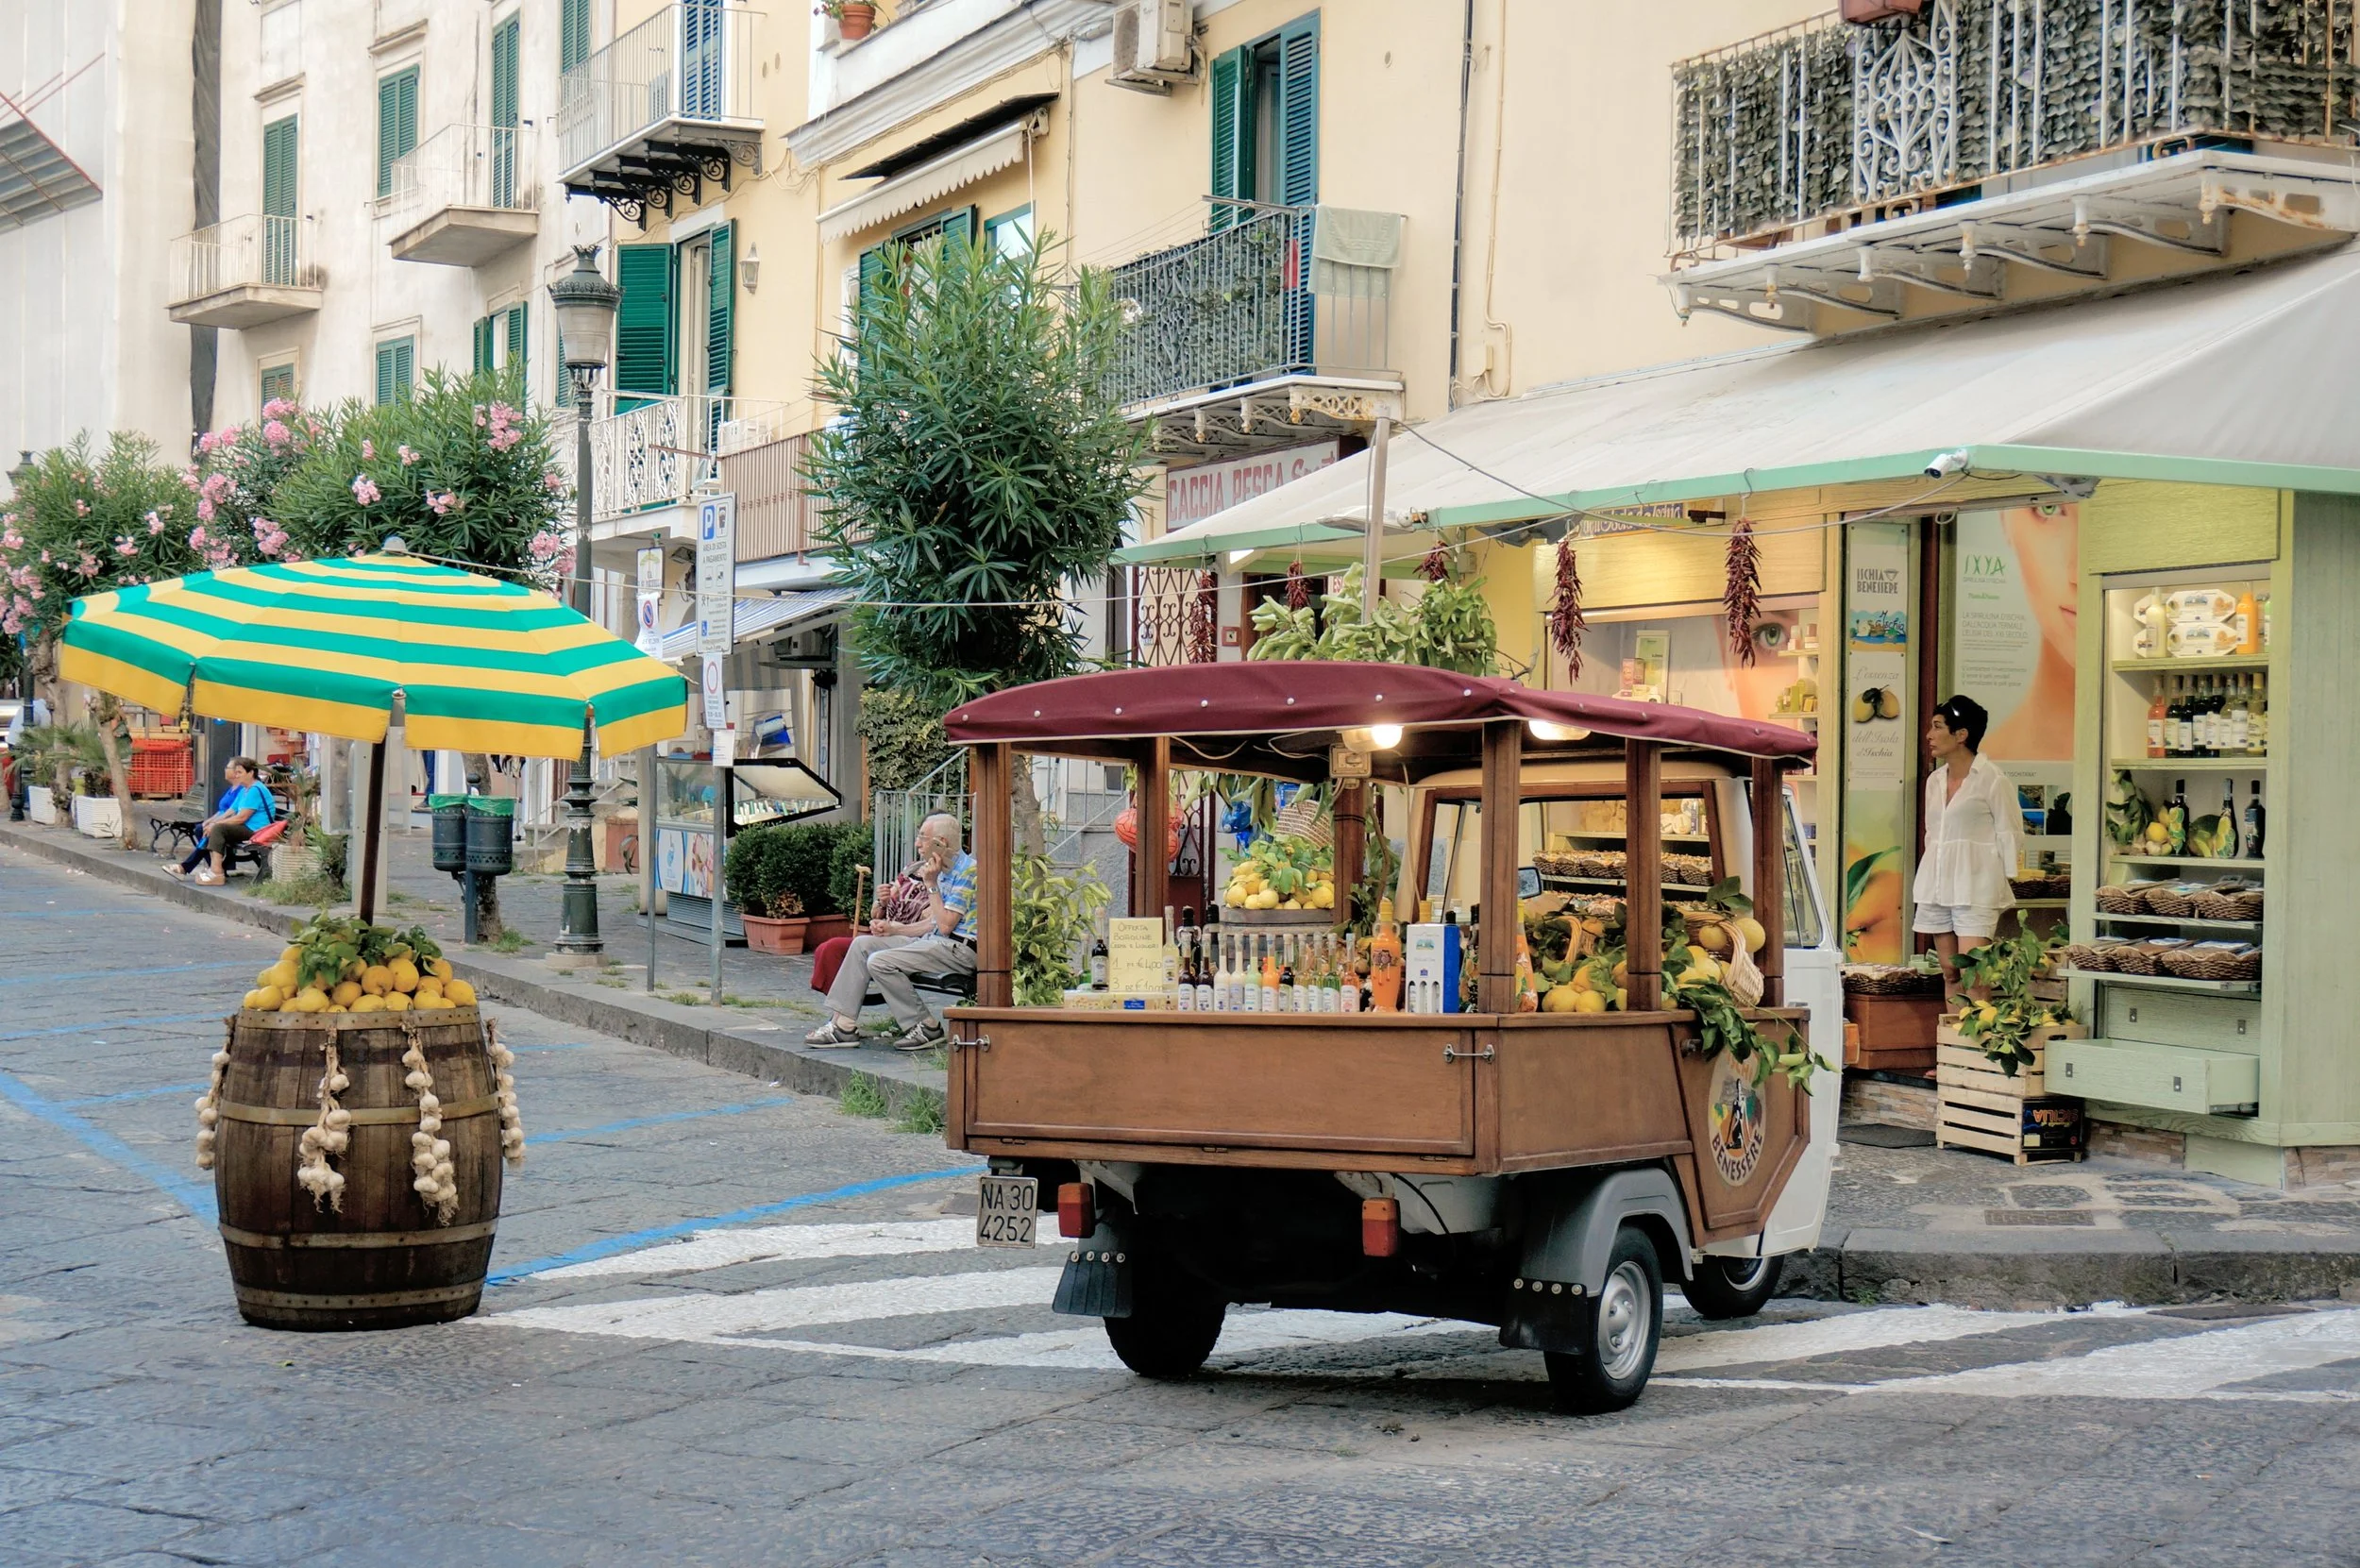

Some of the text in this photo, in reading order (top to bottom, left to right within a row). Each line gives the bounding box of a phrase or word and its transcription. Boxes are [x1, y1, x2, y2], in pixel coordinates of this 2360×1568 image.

[1169, 471, 1224, 522] CACCIA
[704, 508, 714, 538] P
[1857, 568, 1884, 582] ISCHIA
[1964, 553, 2007, 576] IXYA
[1118, 922, 1149, 932] OFFERTA
[1112, 977, 1121, 990] 3
[1711, 1130, 1762, 1181] BENESSERE
[980, 1183, 1005, 1211] NA
[979, 1214, 1032, 1243] 4252
